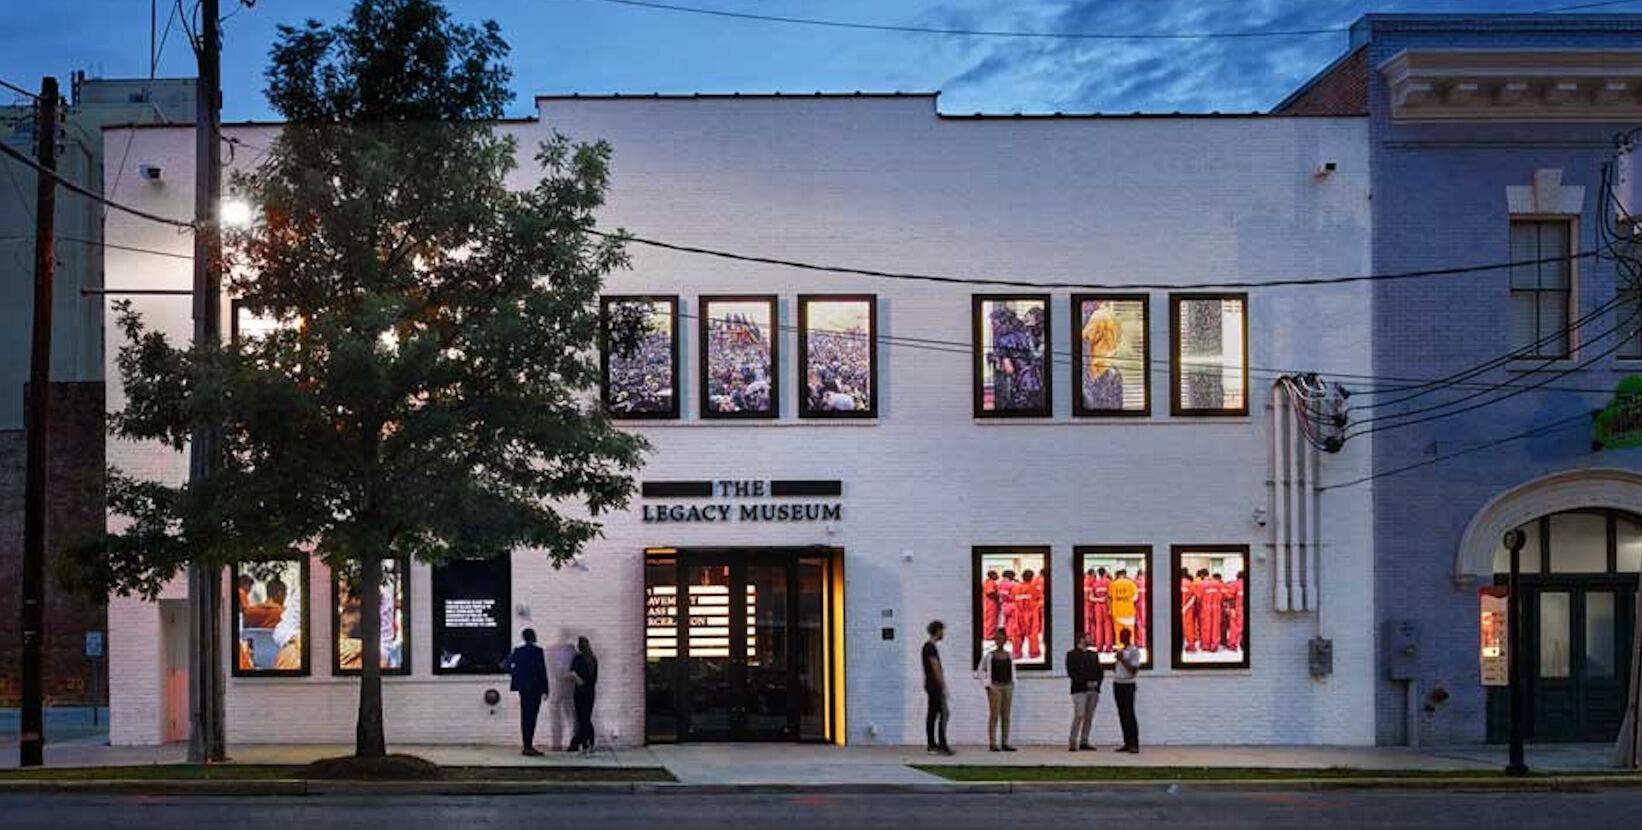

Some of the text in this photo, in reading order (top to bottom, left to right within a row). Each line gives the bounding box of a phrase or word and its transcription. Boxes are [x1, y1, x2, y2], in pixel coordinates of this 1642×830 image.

[719, 481, 764, 497] THE
[643, 504, 841, 521] LEGACY MUSEUM
